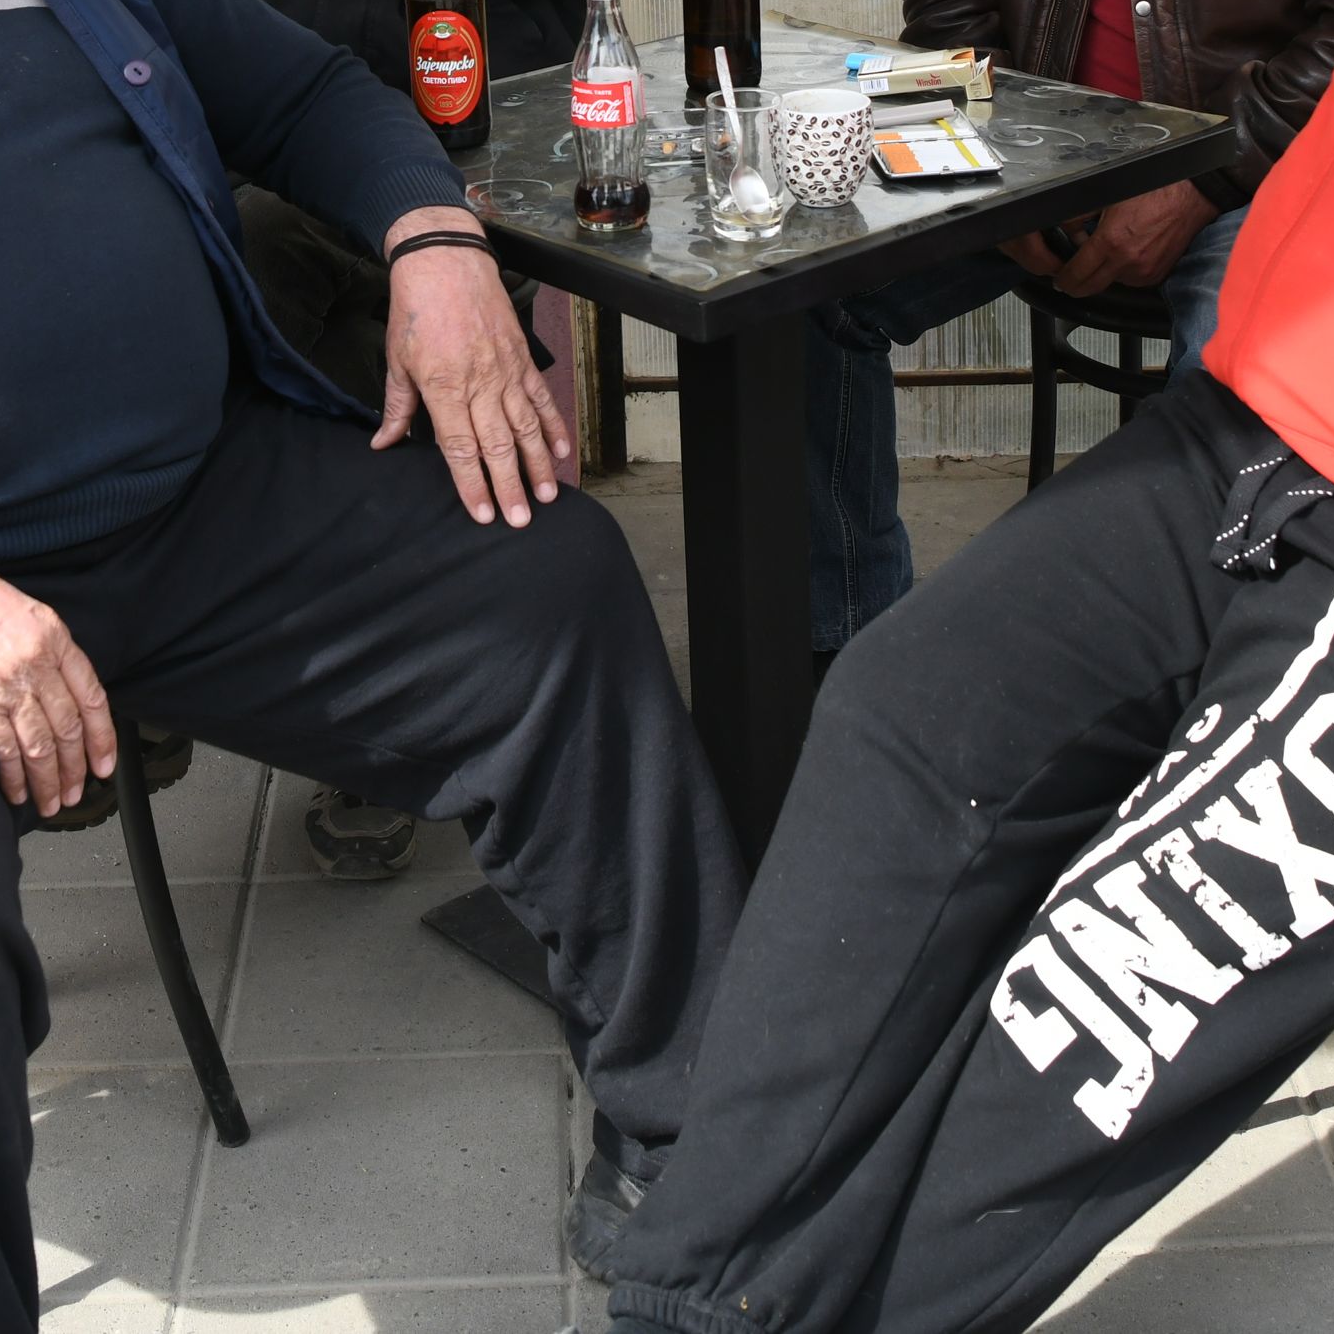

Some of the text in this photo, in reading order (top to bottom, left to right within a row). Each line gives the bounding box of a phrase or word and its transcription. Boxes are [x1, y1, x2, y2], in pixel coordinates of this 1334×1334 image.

[415, 55, 475, 76] Зајечарско
[422, 76, 467, 84] СВЕТЛО ПИВО
[916, 78, 942, 88] Winston
